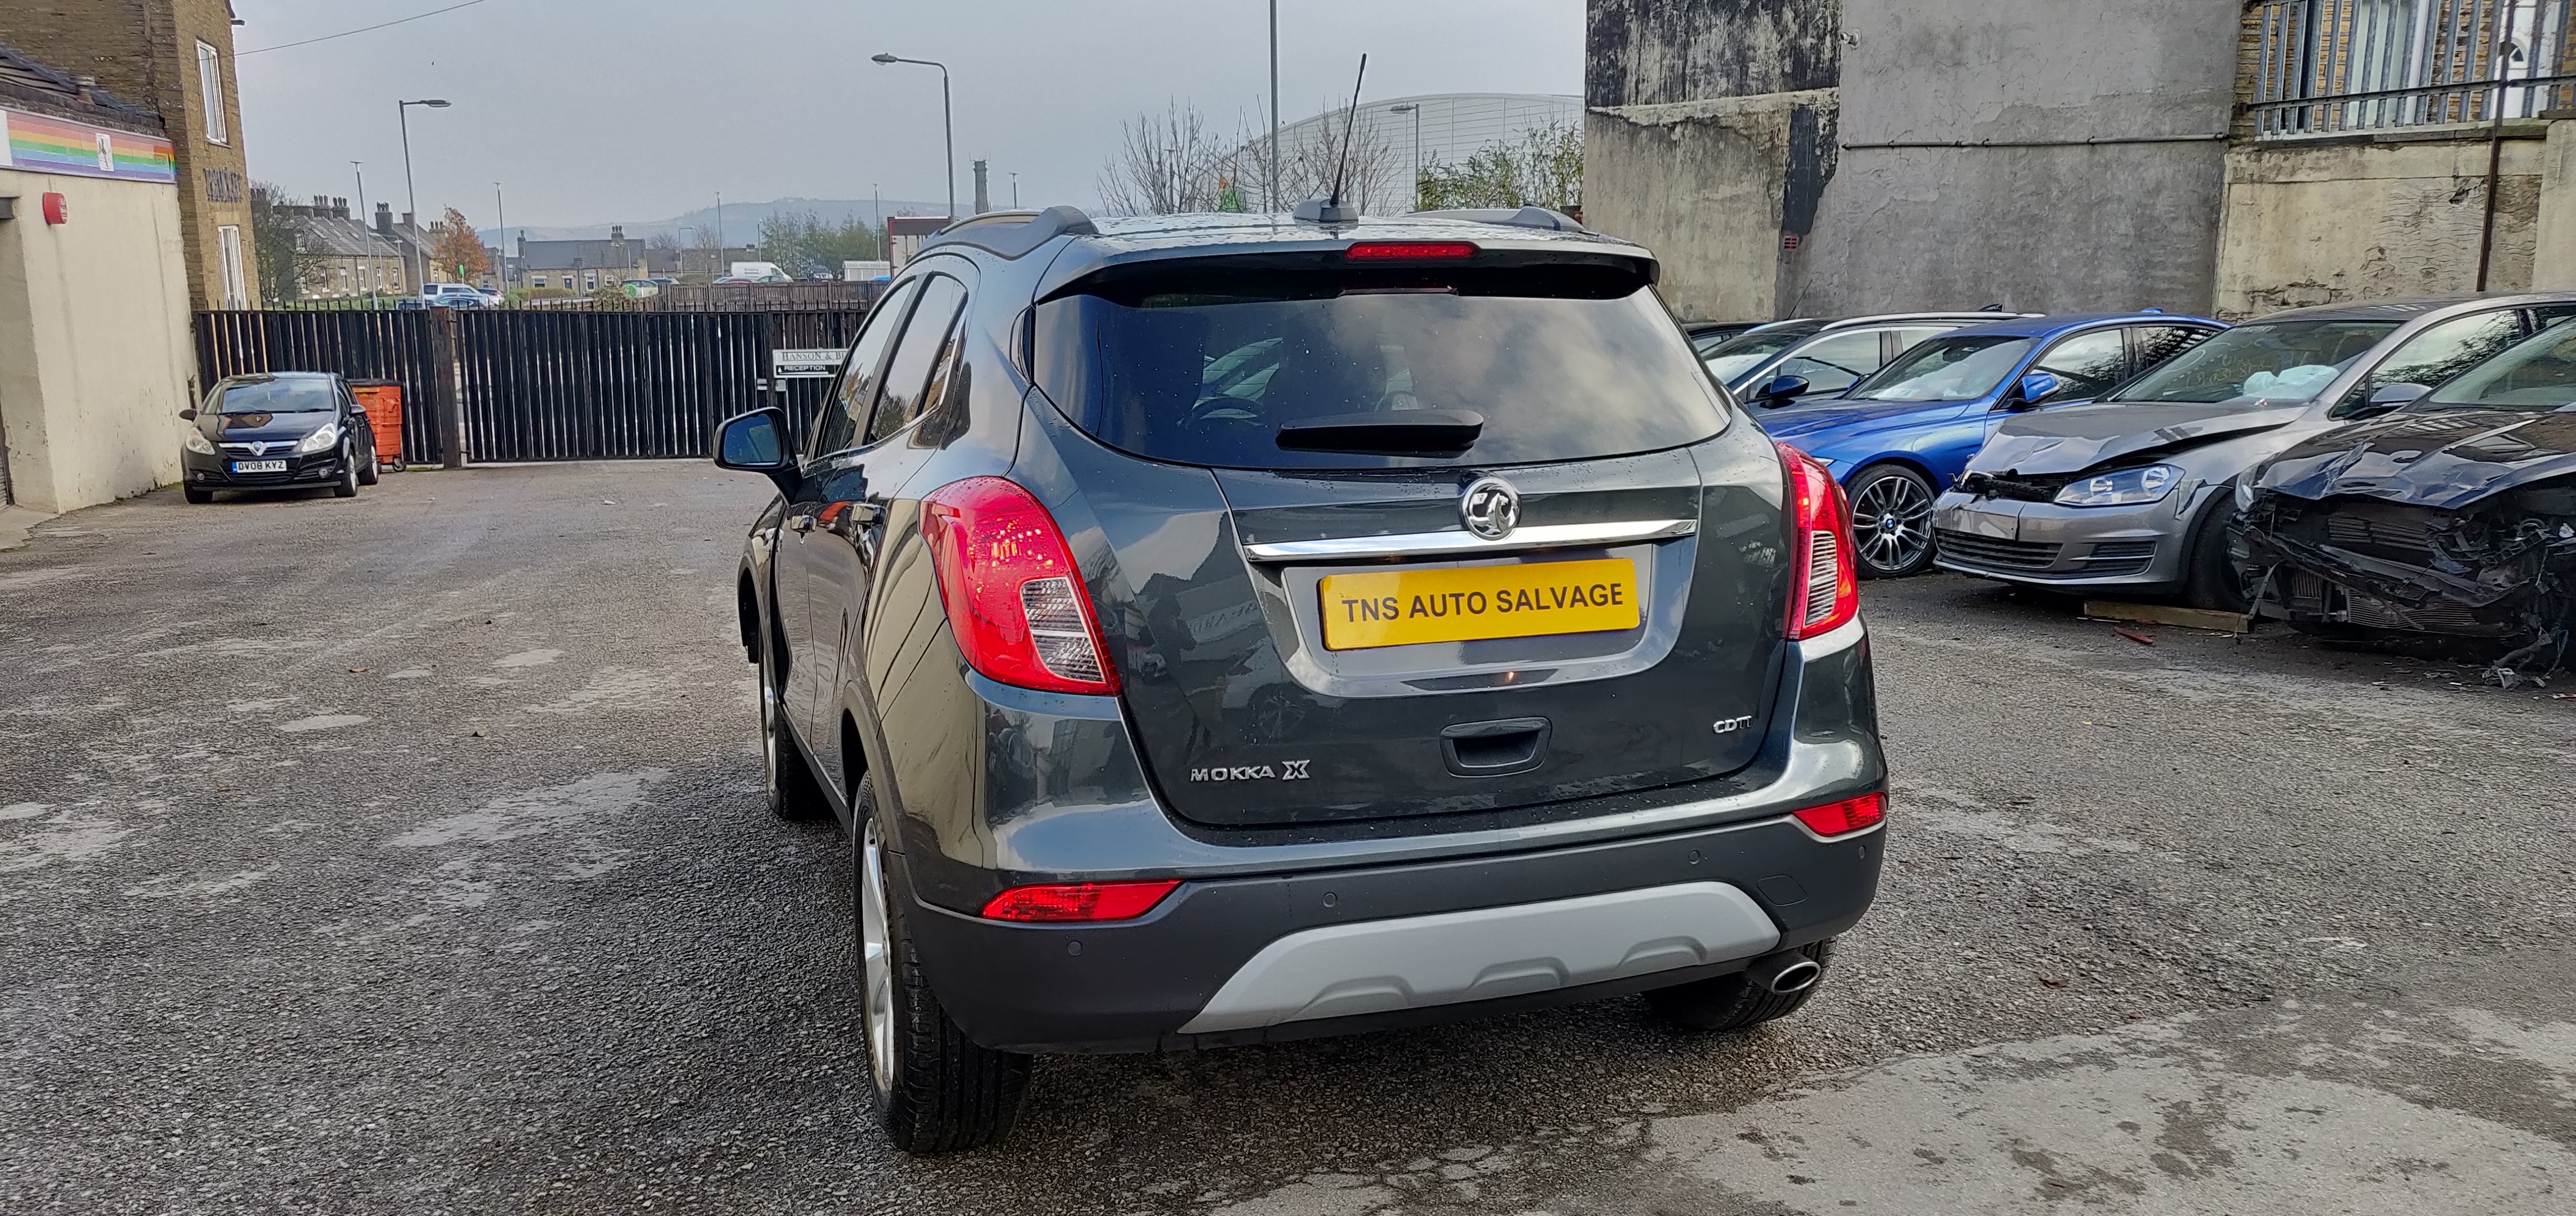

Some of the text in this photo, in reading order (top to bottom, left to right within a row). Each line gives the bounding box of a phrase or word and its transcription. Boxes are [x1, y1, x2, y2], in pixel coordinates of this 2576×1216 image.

[783, 352, 821, 360] HANSON
[825, 352, 832, 360] &
[238, 461, 284, 470] DV08 KYZ
[1342, 583, 1623, 623] TNS AUTO SALVAGE
[1713, 715, 1752, 733] CDTI
[1190, 759, 1310, 782] MOKKA X
